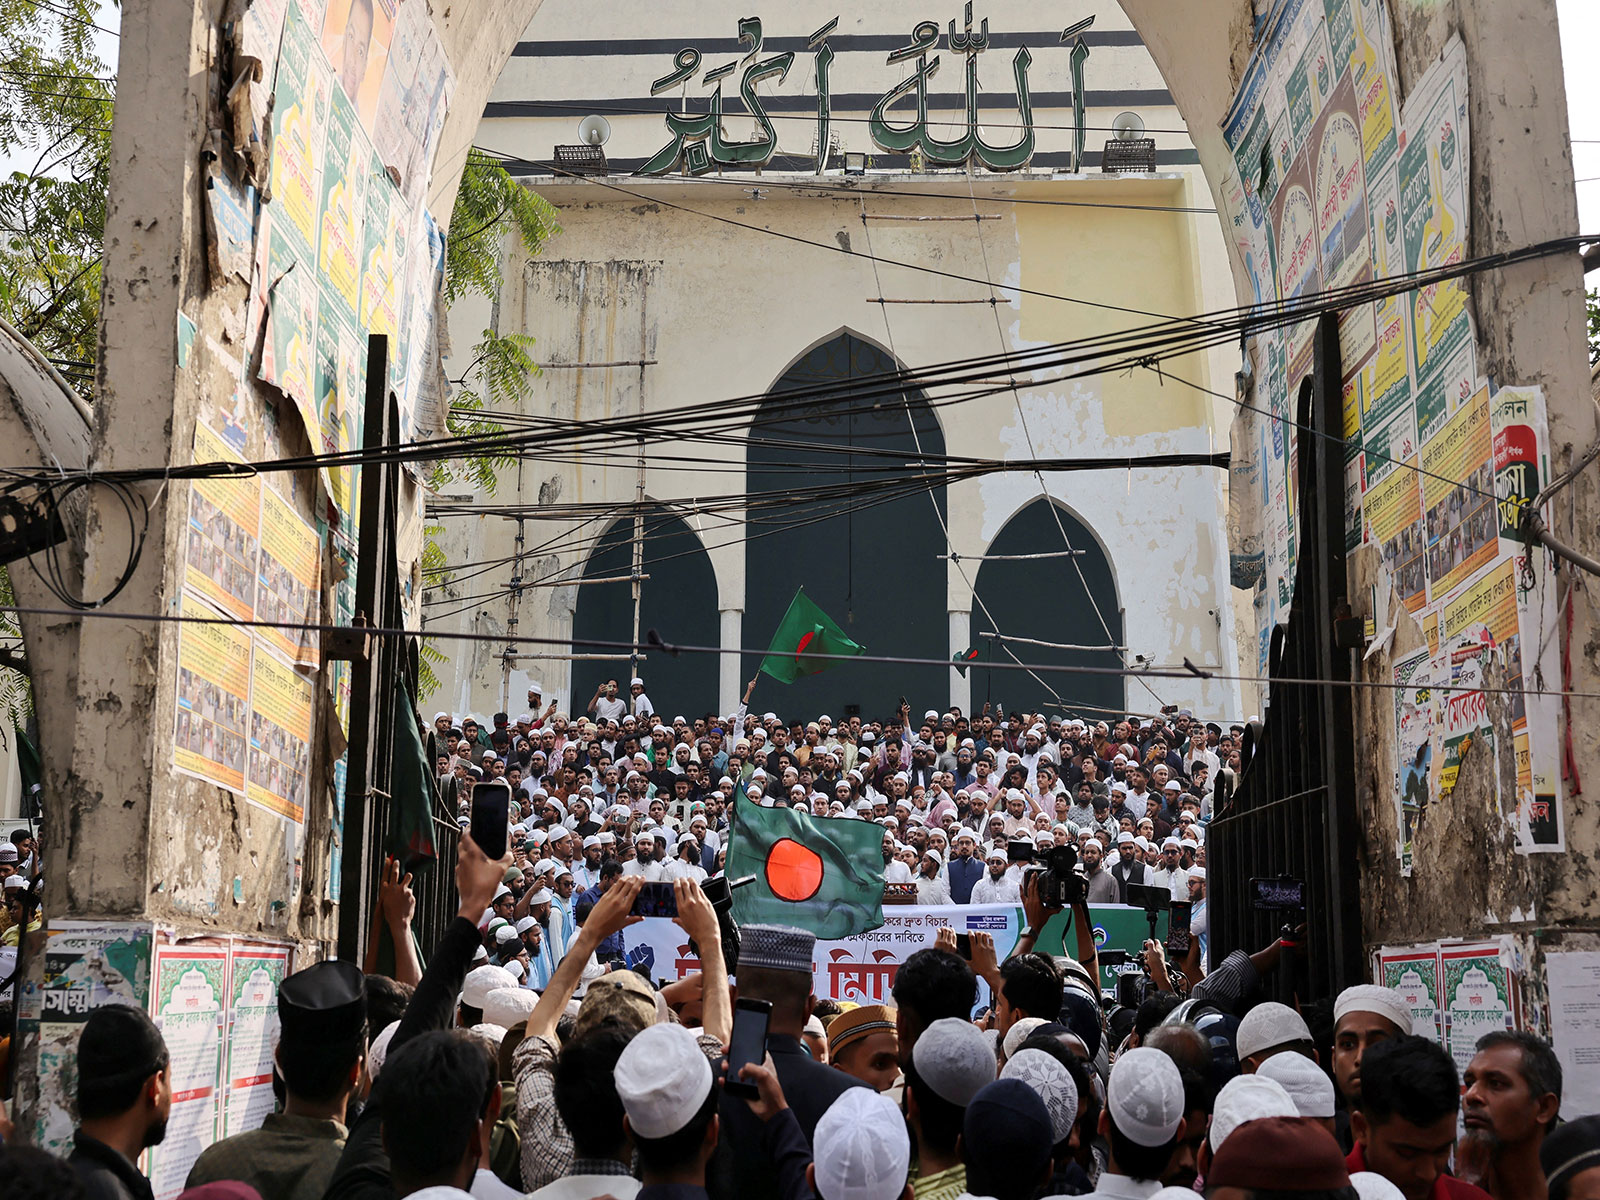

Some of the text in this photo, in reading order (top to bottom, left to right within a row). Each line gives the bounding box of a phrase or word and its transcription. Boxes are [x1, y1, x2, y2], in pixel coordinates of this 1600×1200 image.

[1448, 690, 1486, 732] মোবারক
[904, 916, 922, 928] দ্রুত
[895, 929, 925, 943] দাবিতে
